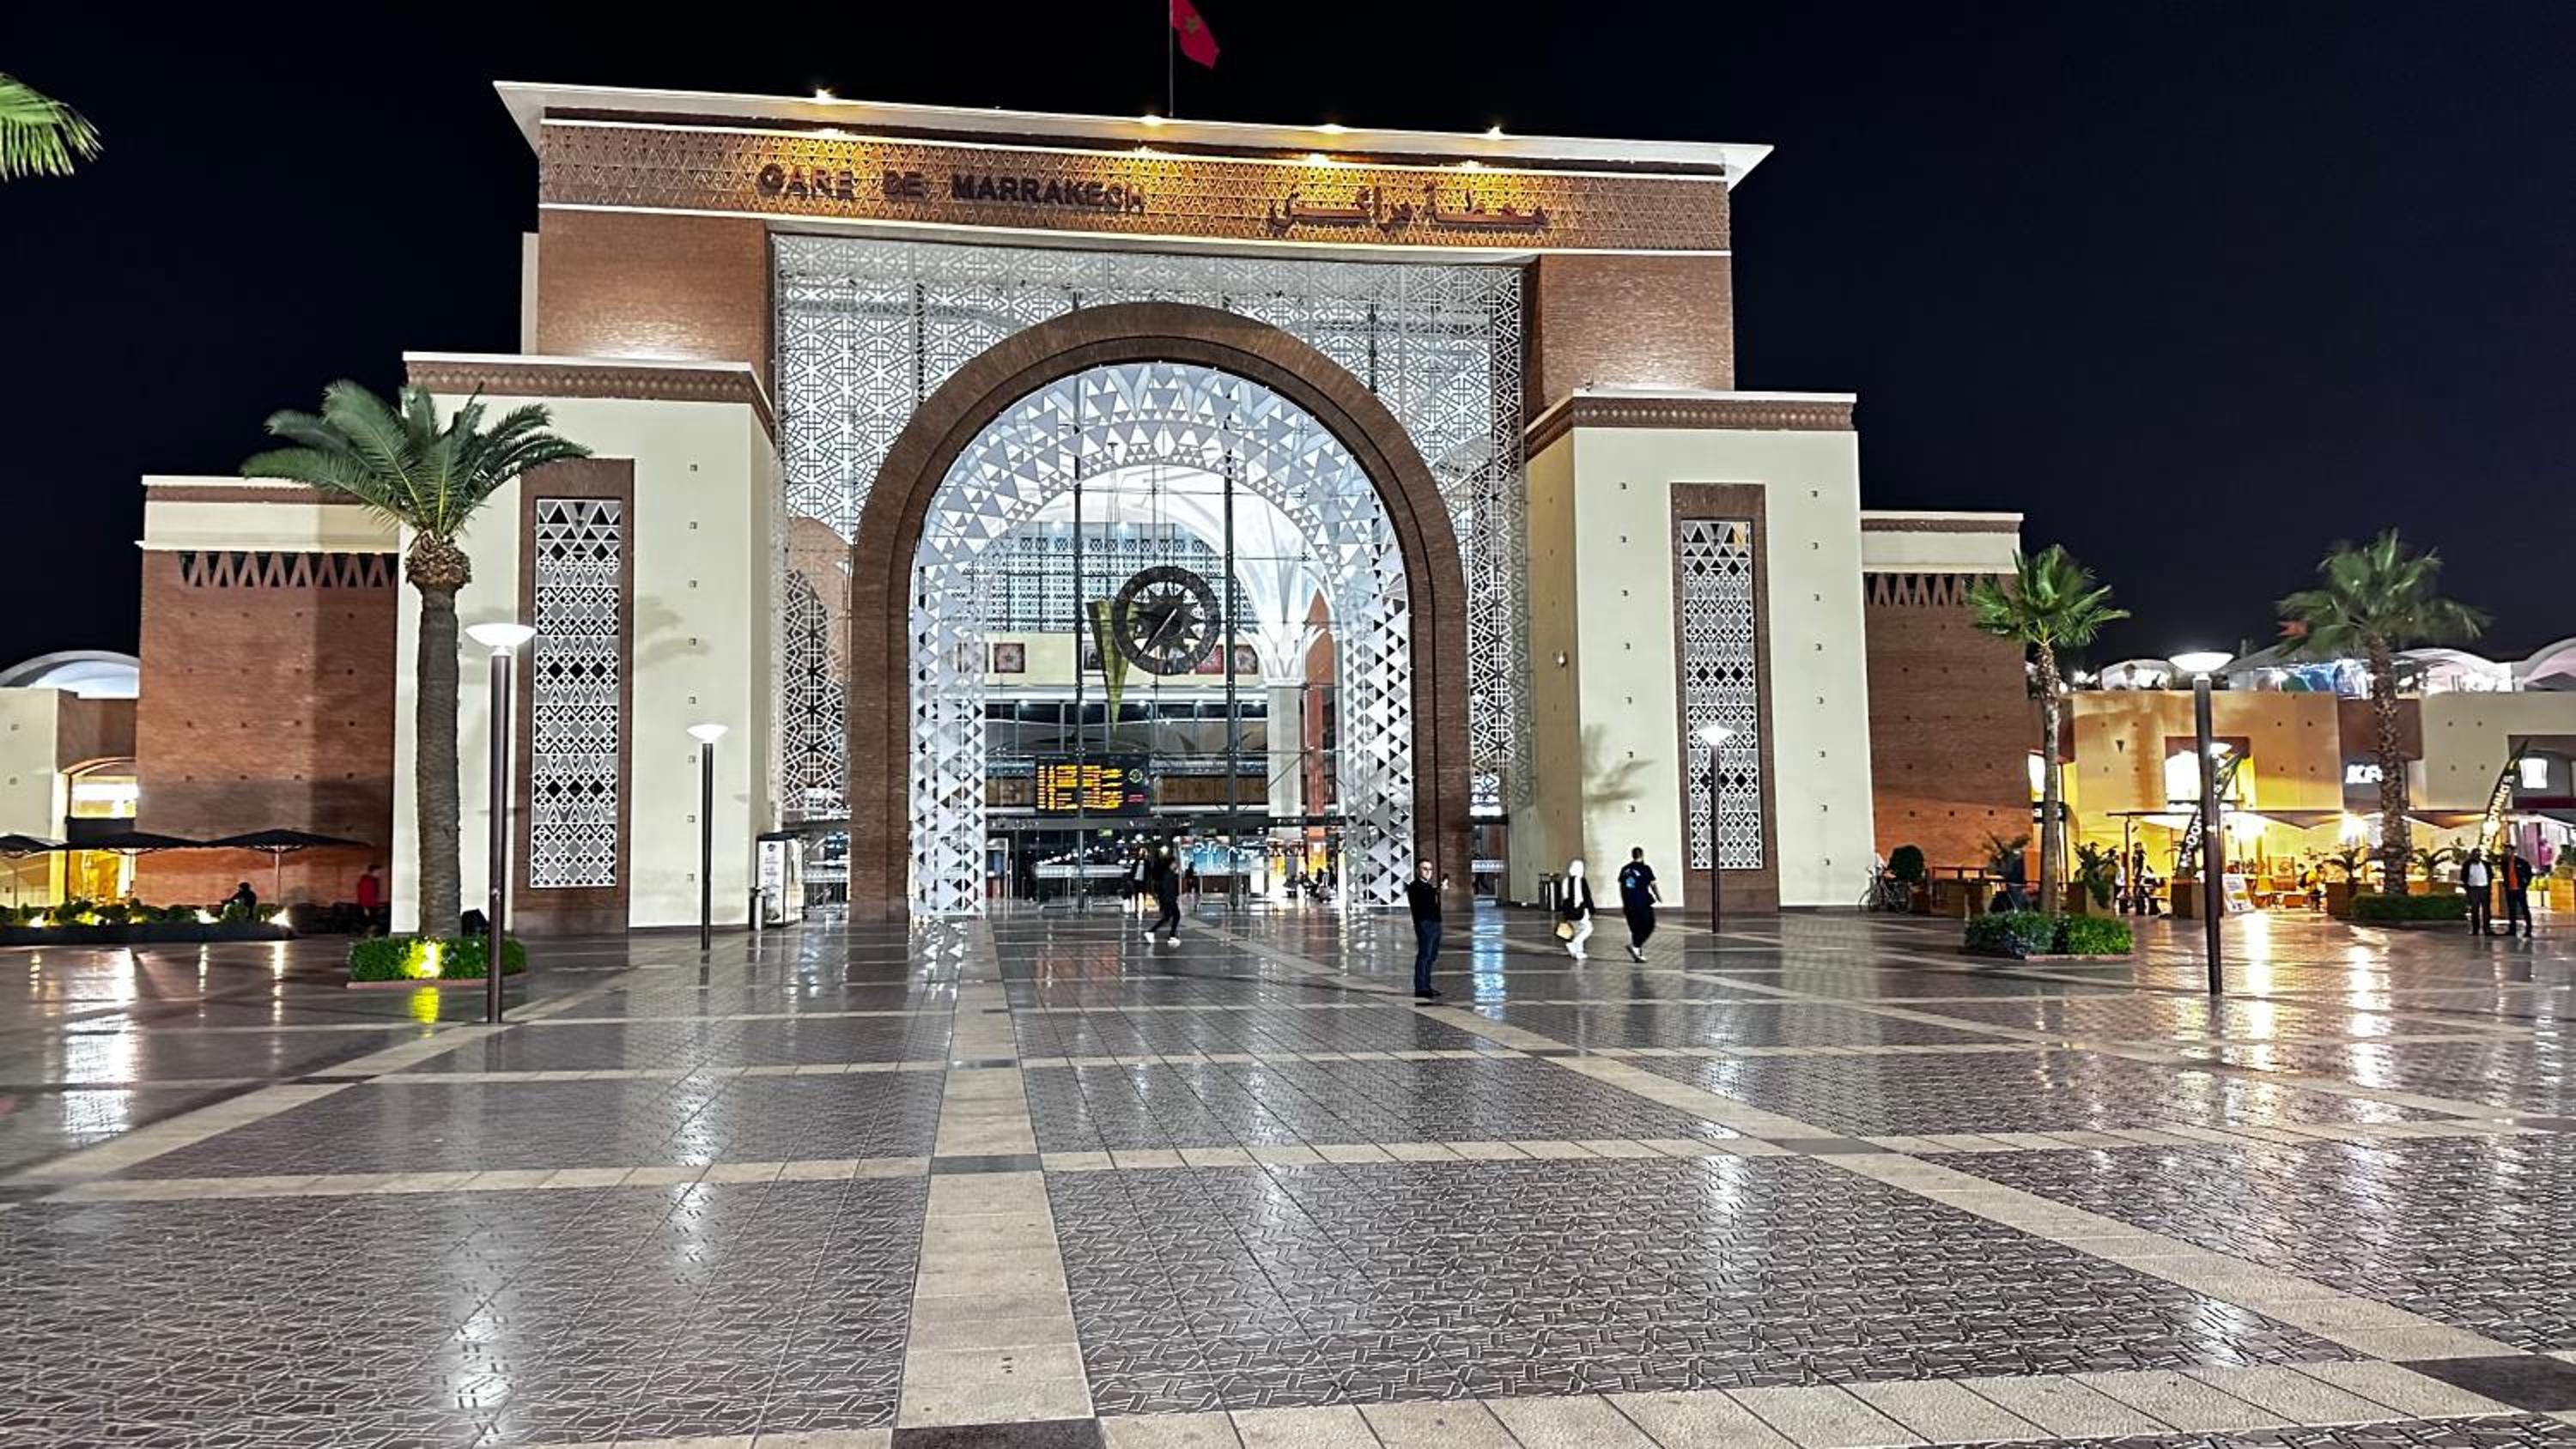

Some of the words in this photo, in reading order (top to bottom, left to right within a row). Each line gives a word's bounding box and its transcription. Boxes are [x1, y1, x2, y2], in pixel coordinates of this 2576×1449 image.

[759, 163, 854, 197] GARE
[883, 170, 927, 200] DE
[951, 173, 1143, 210] MARRAKECH
